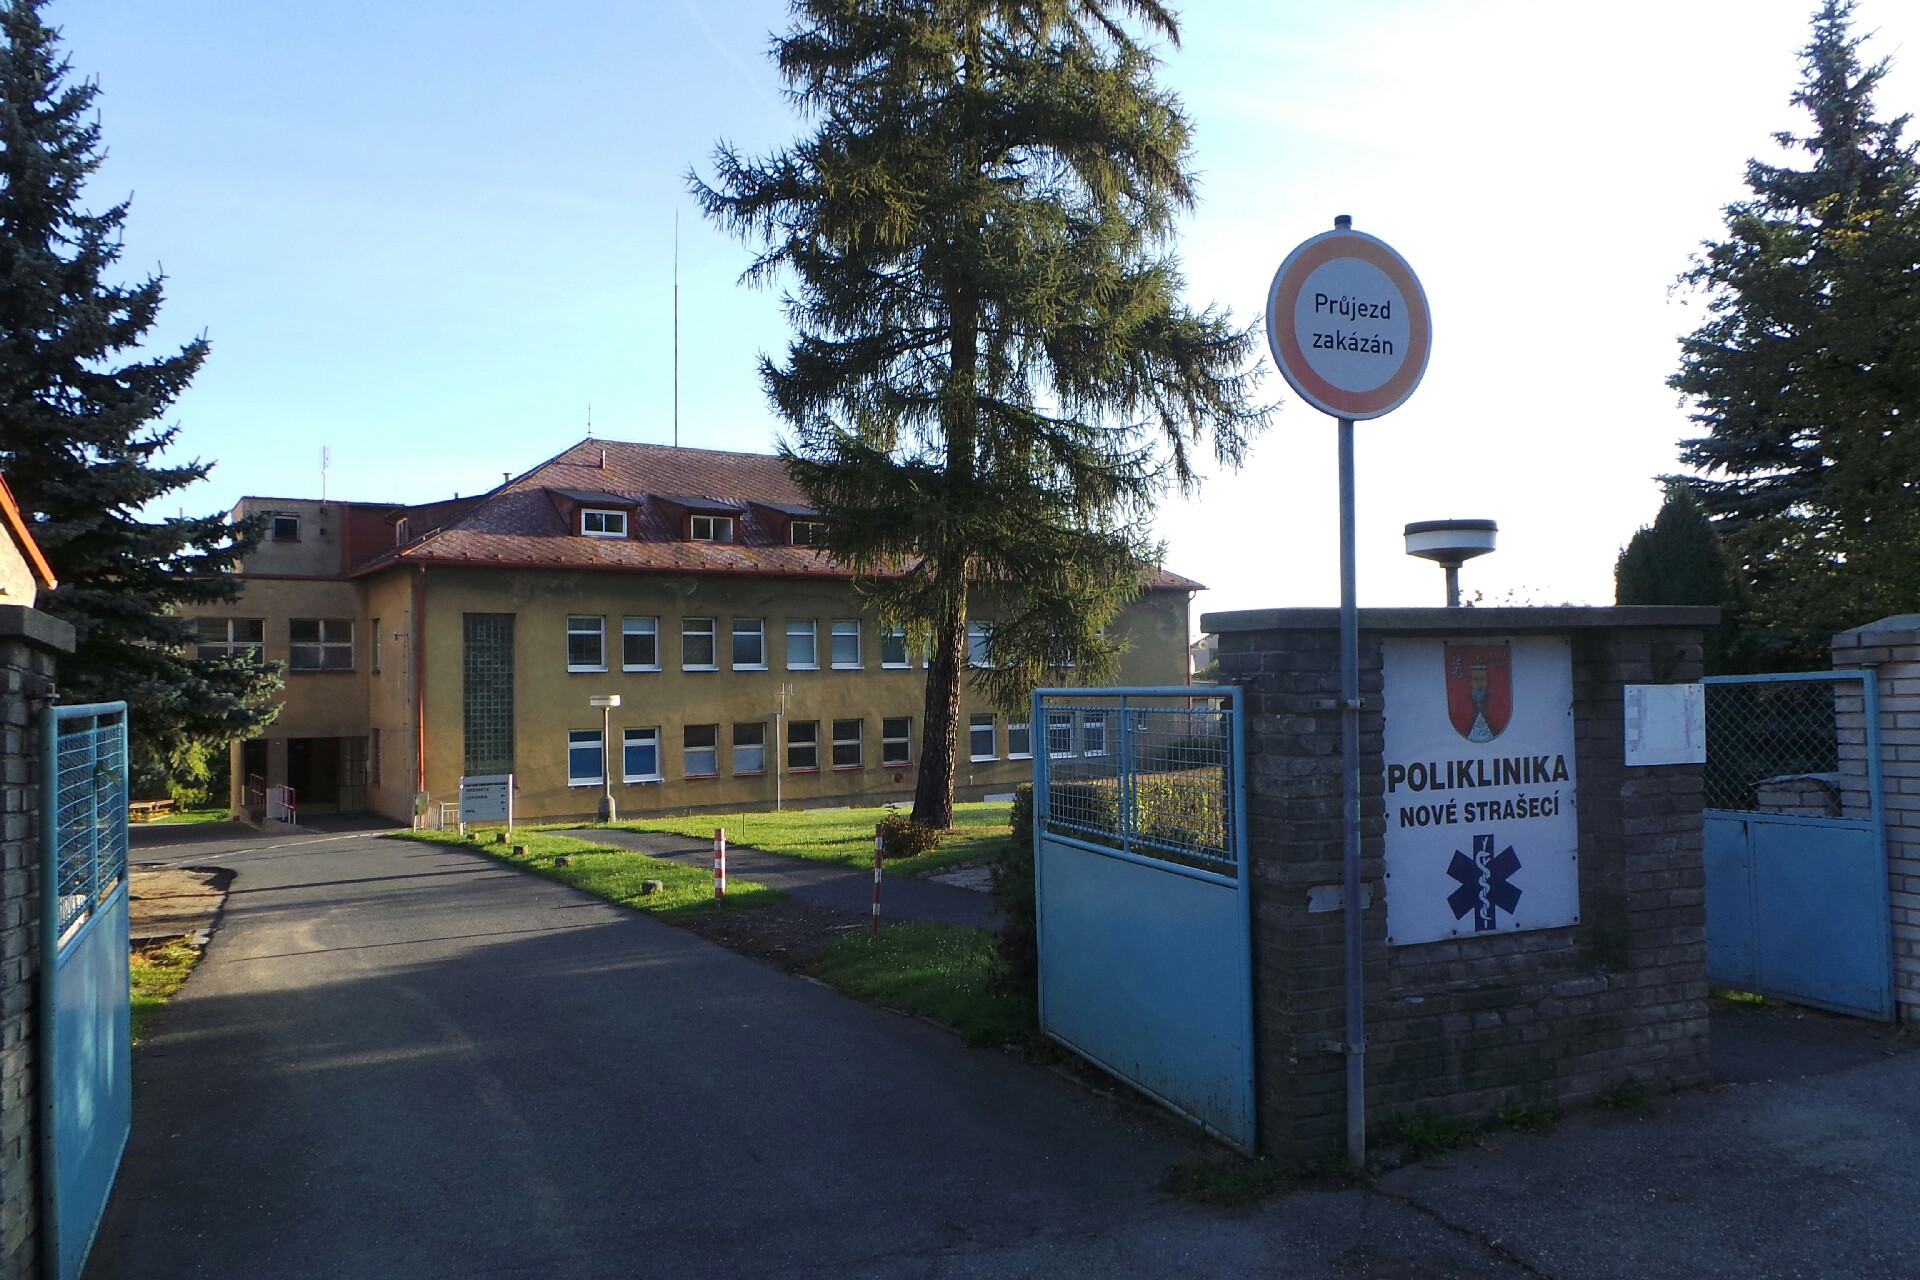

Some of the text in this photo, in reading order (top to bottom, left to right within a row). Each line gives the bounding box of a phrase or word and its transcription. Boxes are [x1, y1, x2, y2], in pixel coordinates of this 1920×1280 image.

[1315, 293, 1391, 321] Průjezd
[1312, 330, 1393, 355] zakázán
[1387, 754, 1570, 793] POLIKLINIKA
[1400, 790, 1560, 828] NOVÉ STRAŠECÍ
